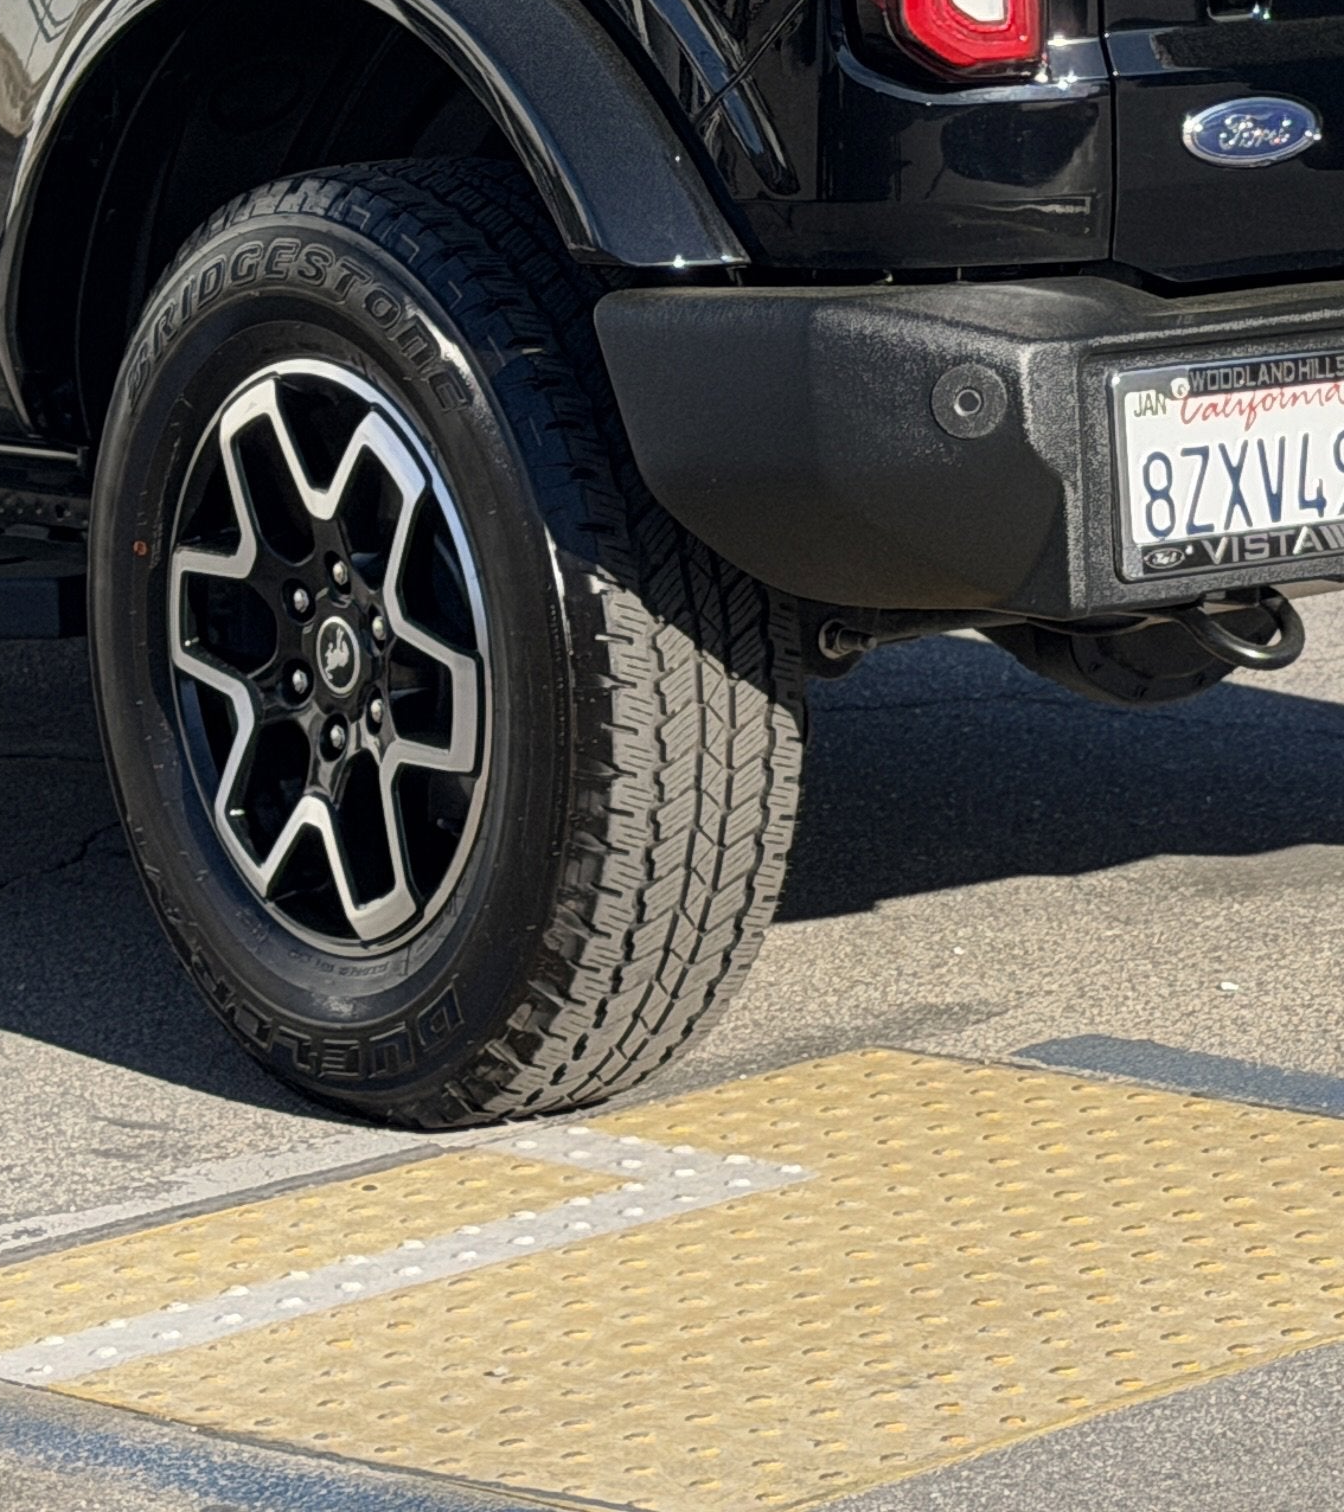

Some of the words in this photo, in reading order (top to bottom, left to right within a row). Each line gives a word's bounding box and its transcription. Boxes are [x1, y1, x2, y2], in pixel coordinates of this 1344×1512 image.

[1219, 113, 1292, 151] Ford
[125, 237, 469, 415] BRIDGESTONE
[1190, 361, 1296, 392] WOODLAND
[1133, 391, 1167, 418] JAN
[1200, 525, 1326, 565] VISTA
